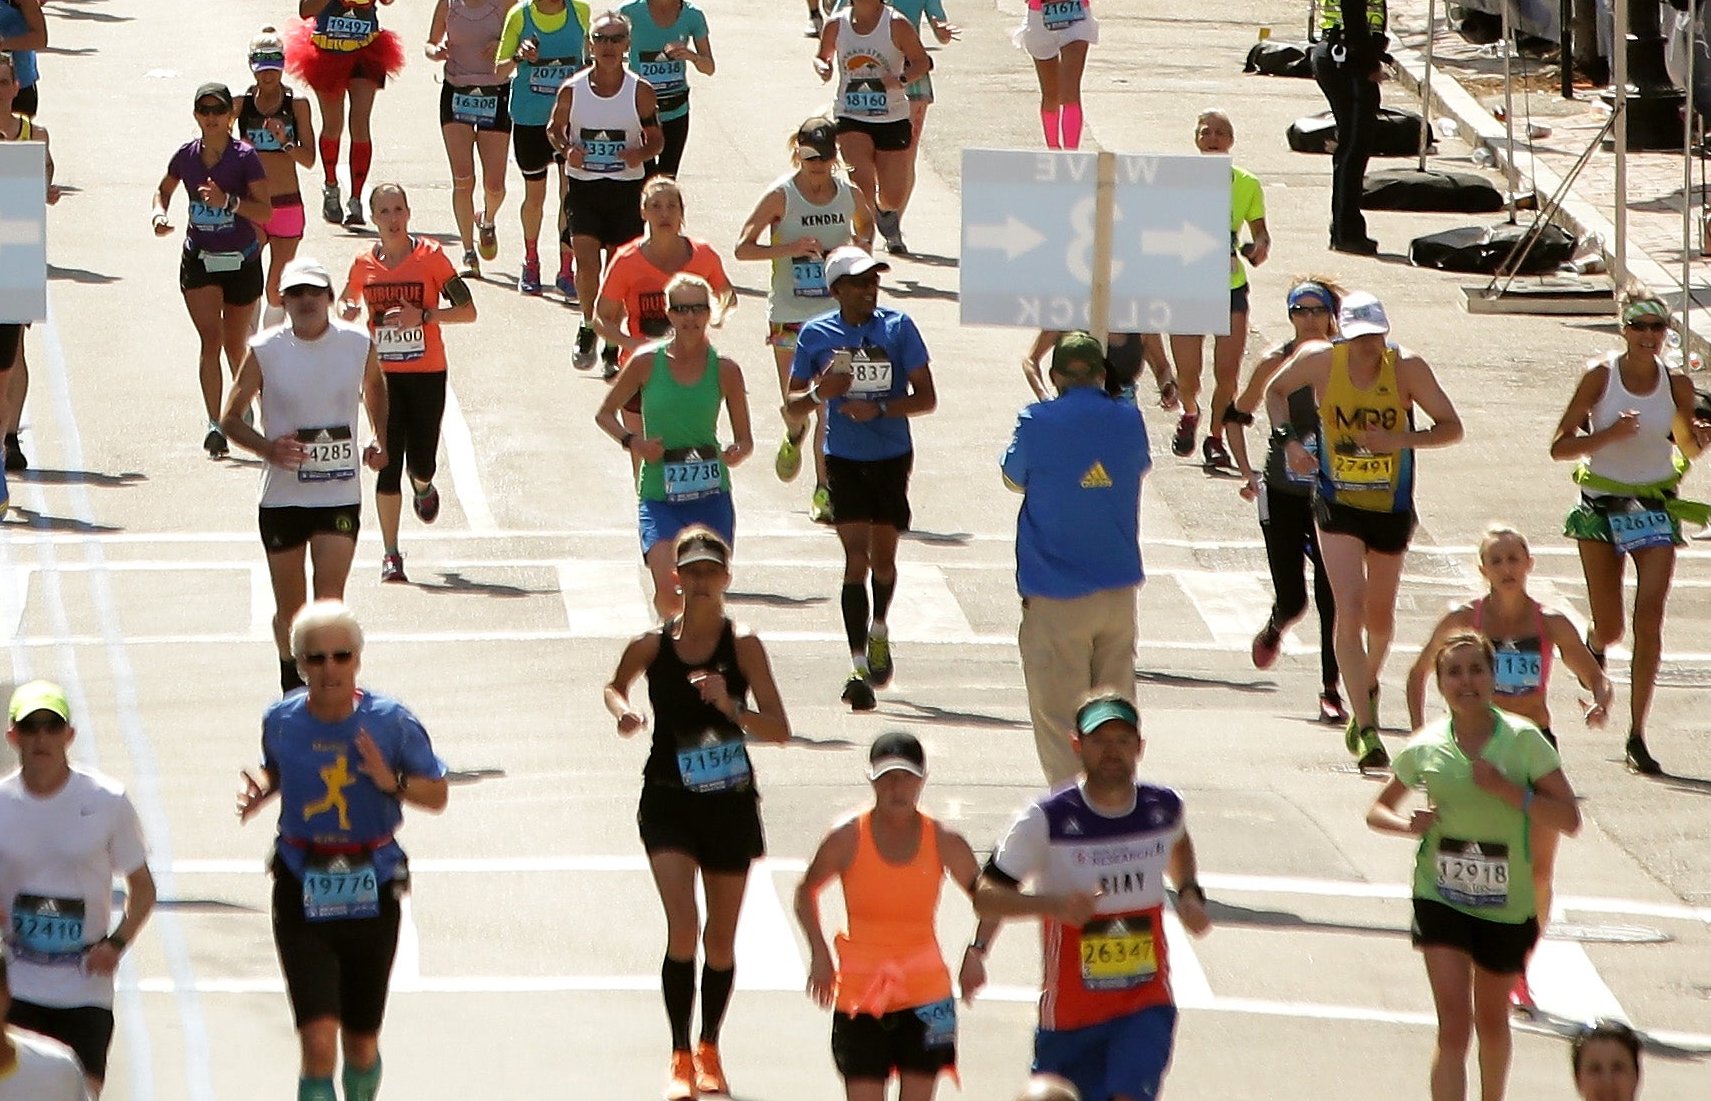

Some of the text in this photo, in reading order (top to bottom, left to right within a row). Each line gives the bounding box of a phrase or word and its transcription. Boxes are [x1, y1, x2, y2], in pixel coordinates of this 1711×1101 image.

[1043, 1, 1083, 16] 21671
[329, 17, 371, 33] 19497
[642, 63, 681, 77] 20638
[454, 95, 497, 110] 16308
[846, 93, 887, 107] 18160
[800, 213, 846, 227] KENDRA
[310, 443, 353, 463] 4285
[666, 462, 721, 482] 22738
[1336, 457, 1392, 475] 27491
[1495, 654, 1540, 676] 1136
[683, 745, 744, 772] 21564
[1439, 860, 1508, 884] 12918
[306, 871, 374, 896] 19776
[13, 914, 83, 941] 22410
[1083, 939, 1152, 966] 26347
